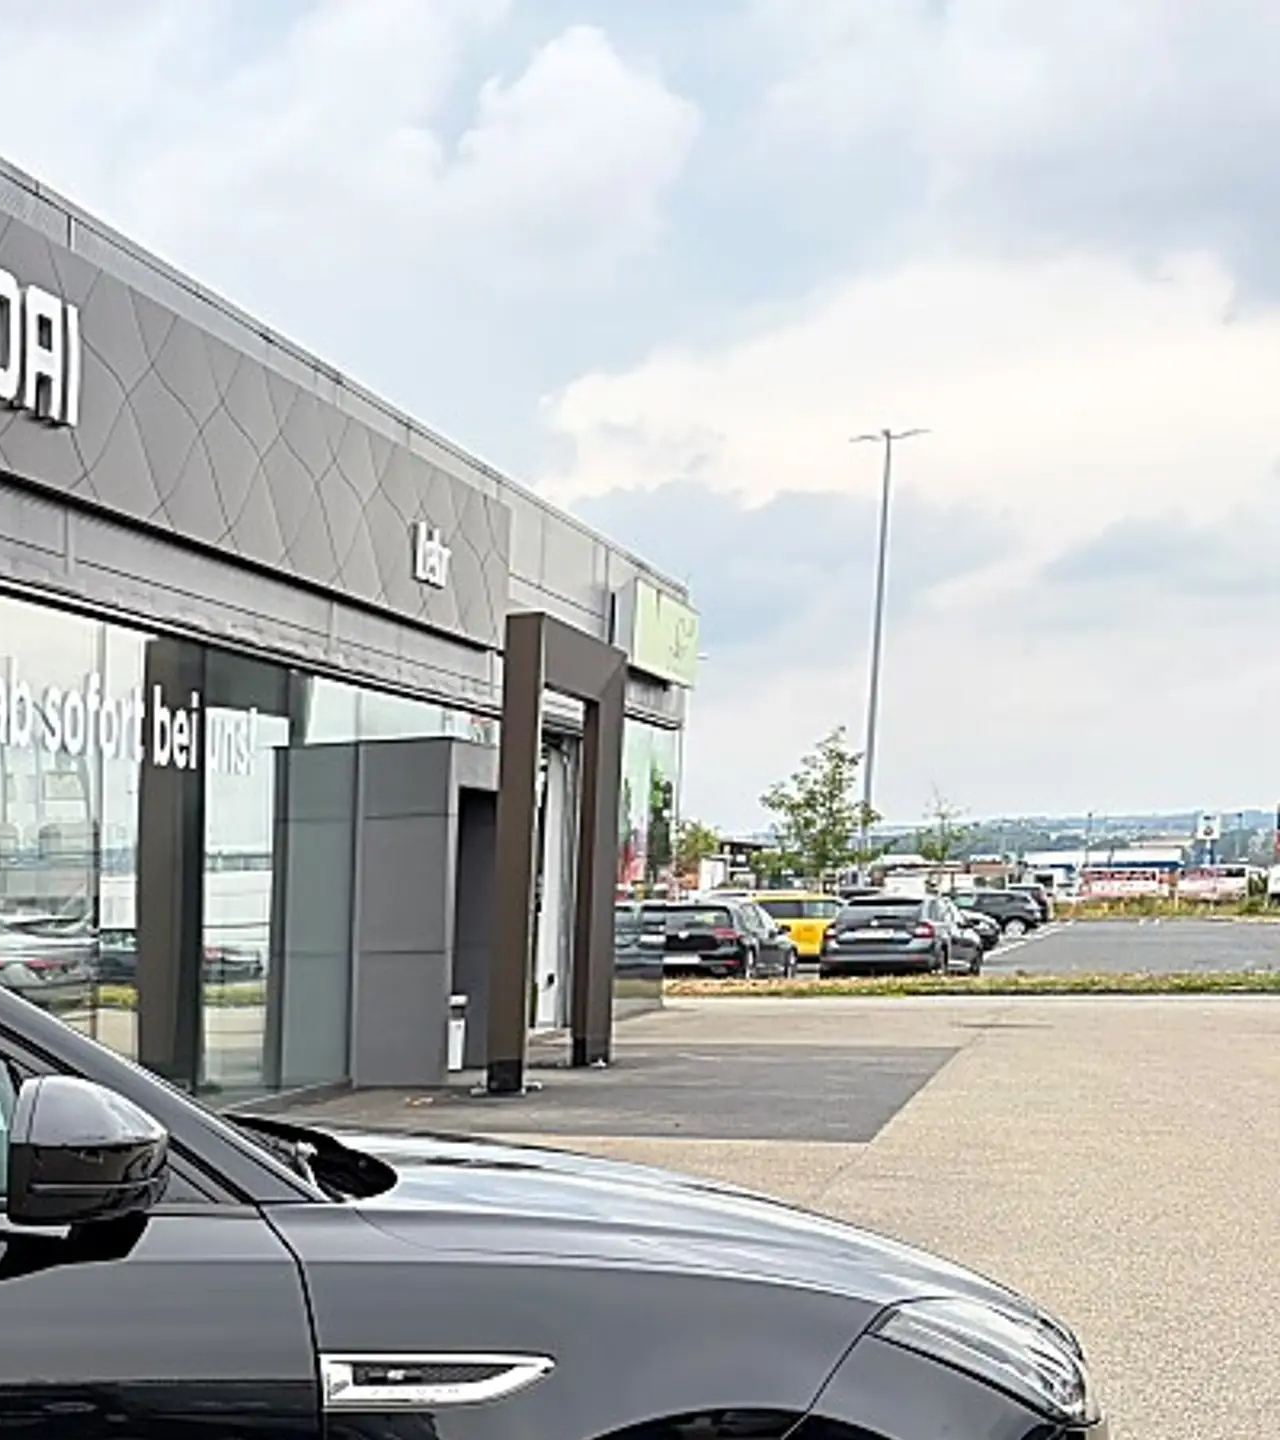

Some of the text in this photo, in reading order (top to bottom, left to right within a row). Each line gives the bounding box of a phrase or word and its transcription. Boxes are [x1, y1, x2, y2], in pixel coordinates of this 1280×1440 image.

[41, 671, 146, 764] sofort
[152, 684, 198, 770] bei
[206, 706, 258, 776] uns!
